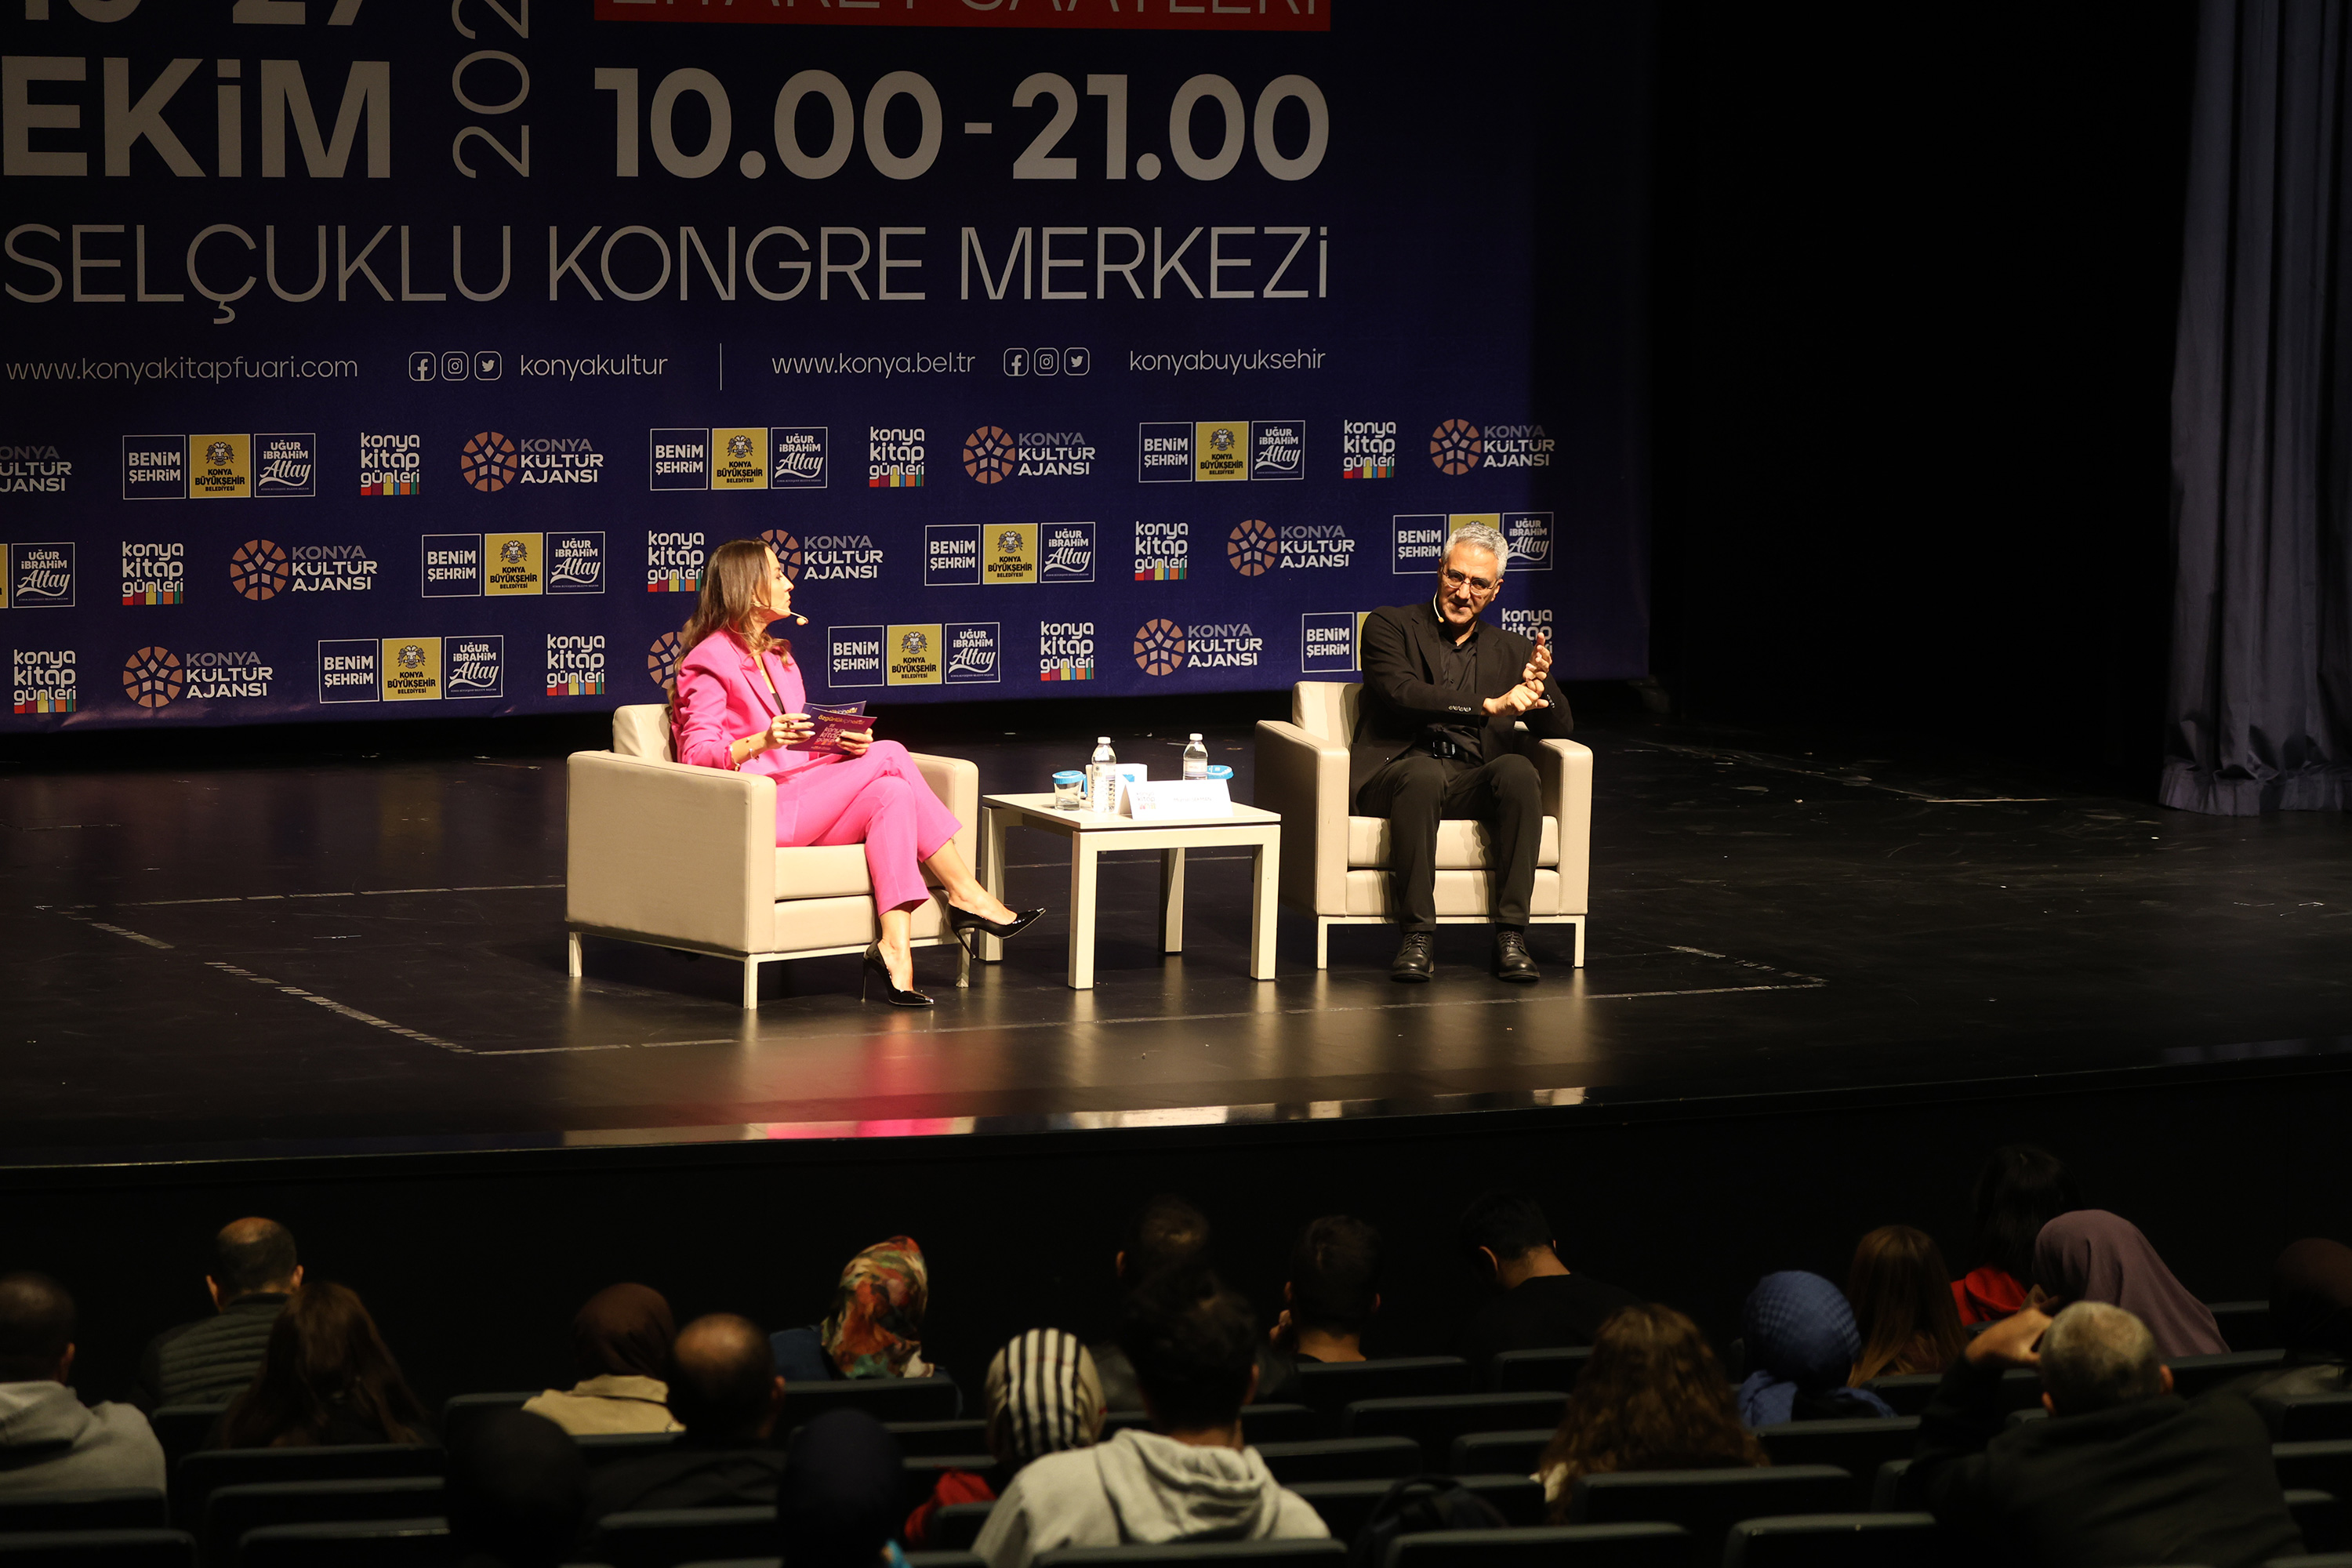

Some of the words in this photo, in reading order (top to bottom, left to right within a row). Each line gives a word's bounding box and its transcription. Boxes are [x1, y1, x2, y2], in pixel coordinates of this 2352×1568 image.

[595, 68, 942, 180] 10.00
[964, 122, 992, 134] -
[1013, 73, 1329, 180] 21.00
[5, 224, 510, 324] SELÇUKLU
[550, 226, 925, 301] KONGRE
[6, 356, 358, 384] www.konyakitapfuari.com
[521, 354, 668, 381] konyakultur
[772, 352, 975, 379] www.konya.bel.tr
[1131, 348, 1326, 376] konyabuyuksehir
[870, 426, 924, 445] konya
[1265, 426, 1292, 437] UĞUR
[1345, 419, 1396, 438] konya
[1484, 425, 1546, 438] KONYA
[270, 440, 301, 451] UĞUR
[361, 432, 419, 452] konya
[521, 438, 593, 452] KONYA
[786, 433, 814, 444] UĞUR
[1018, 432, 1085, 446] KONYA
[1344, 435, 1396, 456] kitap
[1484, 440, 1554, 453] KÜLTÜR
[361, 448, 419, 473] kitap
[521, 454, 604, 468] KÜLTÜR
[870, 442, 924, 466] kitap
[1018, 447, 1095, 461] KÜLTÜR
[1254, 445, 1301, 470] Altay
[1344, 454, 1395, 471] günleri
[1483, 454, 1548, 467] AJANSI
[259, 459, 311, 487] Altay
[775, 452, 823, 478] Altay
[869, 462, 924, 480] günleri
[1018, 462, 1090, 476] AJANSI
[361, 469, 419, 488] günleri
[521, 470, 597, 484] AJANSI
[1135, 521, 1189, 539] konya
[1281, 525, 1345, 539] KONYA
[1515, 518, 1541, 528] UĞUR
[648, 530, 704, 550] konya
[804, 535, 873, 550] KONYA
[1055, 528, 1082, 539] UĞUR
[122, 541, 183, 561] konya
[562, 538, 591, 549] UĞUR
[1135, 536, 1188, 557] kitap
[1280, 539, 1355, 554] KÜLTÜR
[1508, 536, 1549, 561] Altay
[28, 549, 60, 561] UĞUR
[292, 546, 366, 560] KONYA
[648, 546, 704, 569] kitap
[804, 550, 883, 564] KÜLTÜR
[1044, 547, 1091, 572] Altay
[1280, 554, 1349, 568] AJANSI
[122, 557, 183, 581] kitap
[292, 561, 377, 575] KÜLTÜR
[550, 557, 601, 584] Altay
[804, 565, 877, 579] AJANSI
[1134, 555, 1188, 573] günleri
[16, 569, 71, 597] Altay
[122, 578, 183, 597] günleri
[292, 576, 371, 592] AJANSI
[1502, 608, 1552, 626] konya
[960, 629, 986, 639] UĞUR
[1041, 621, 1094, 639] konya
[1189, 623, 1253, 638] KONYA
[460, 642, 489, 653] UĞUR
[547, 633, 604, 653] konya
[1040, 636, 1094, 659] kitap
[1188, 638, 1262, 653] KÜLTÜR
[14, 649, 75, 669] konya
[187, 652, 262, 666] KONYA
[547, 649, 604, 672] kitap
[948, 648, 996, 674] Altay
[1040, 655, 1094, 673] günleri
[1188, 652, 1258, 667] AJANSI
[14, 666, 76, 689] kitap
[187, 666, 273, 683] KÜLTÜR
[448, 662, 499, 688] Altay
[546, 669, 604, 688] günleri
[14, 685, 76, 706] günleri
[187, 683, 267, 699] AJANSI
